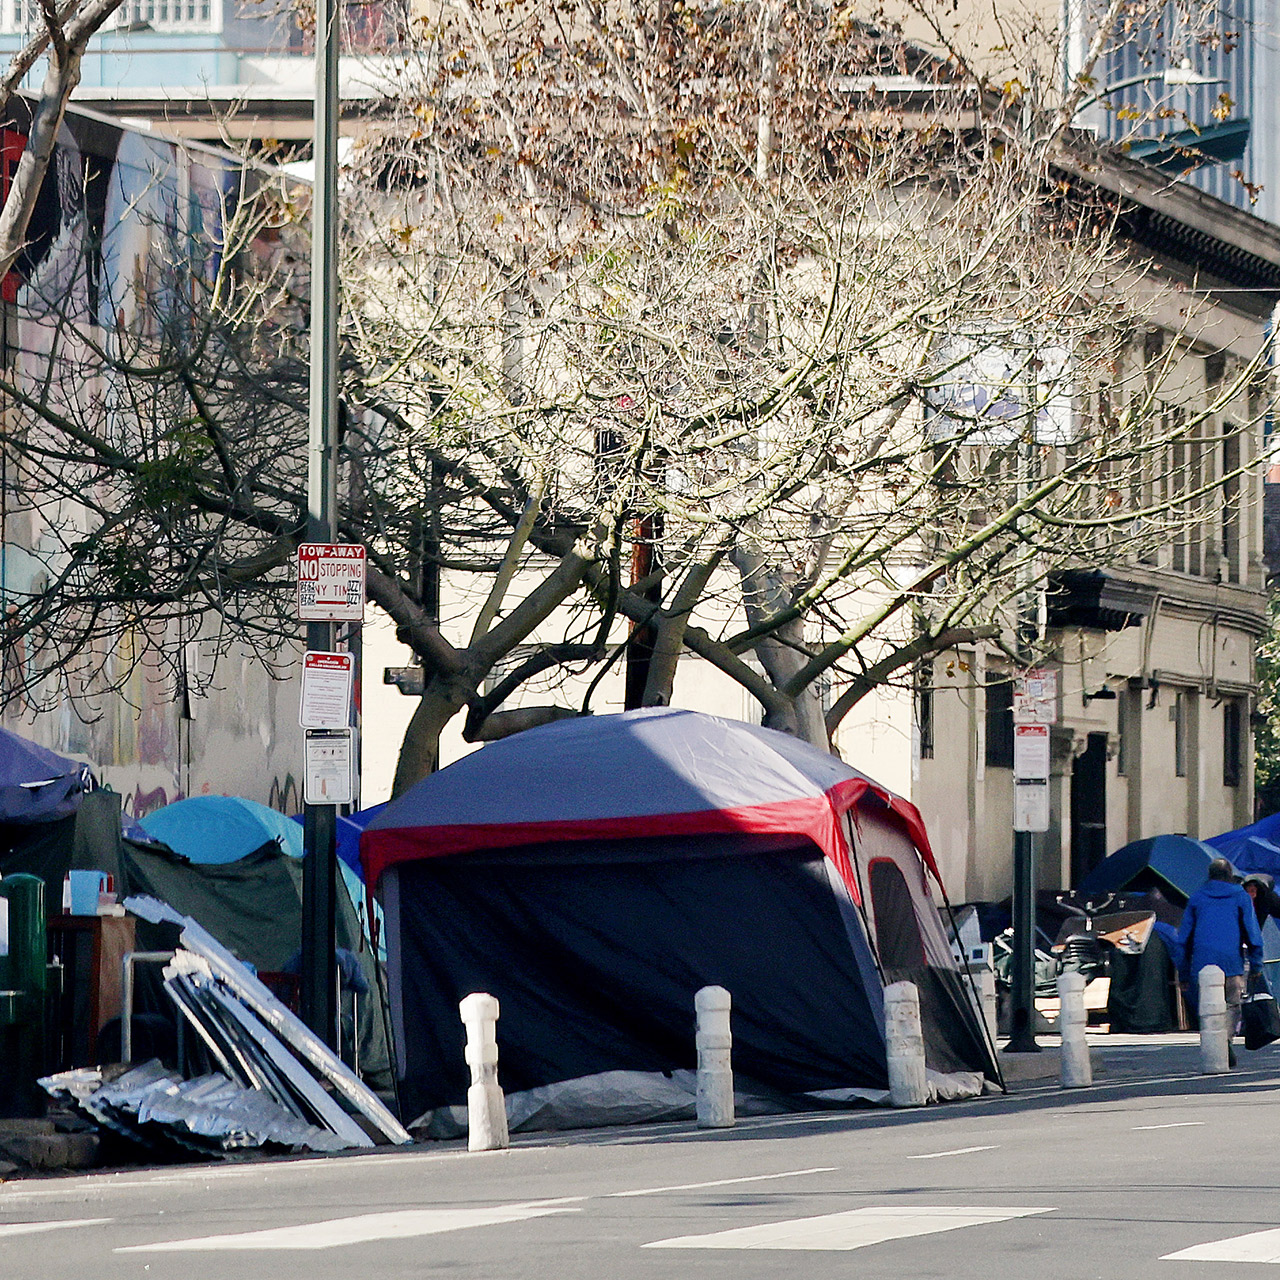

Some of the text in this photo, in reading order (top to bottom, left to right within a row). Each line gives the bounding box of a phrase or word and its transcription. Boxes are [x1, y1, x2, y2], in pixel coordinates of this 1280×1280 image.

[301, 546, 363, 558] TOW-AWAY
[299, 559, 362, 580] NO STOPPING
[315, 584, 328, 596] NY
